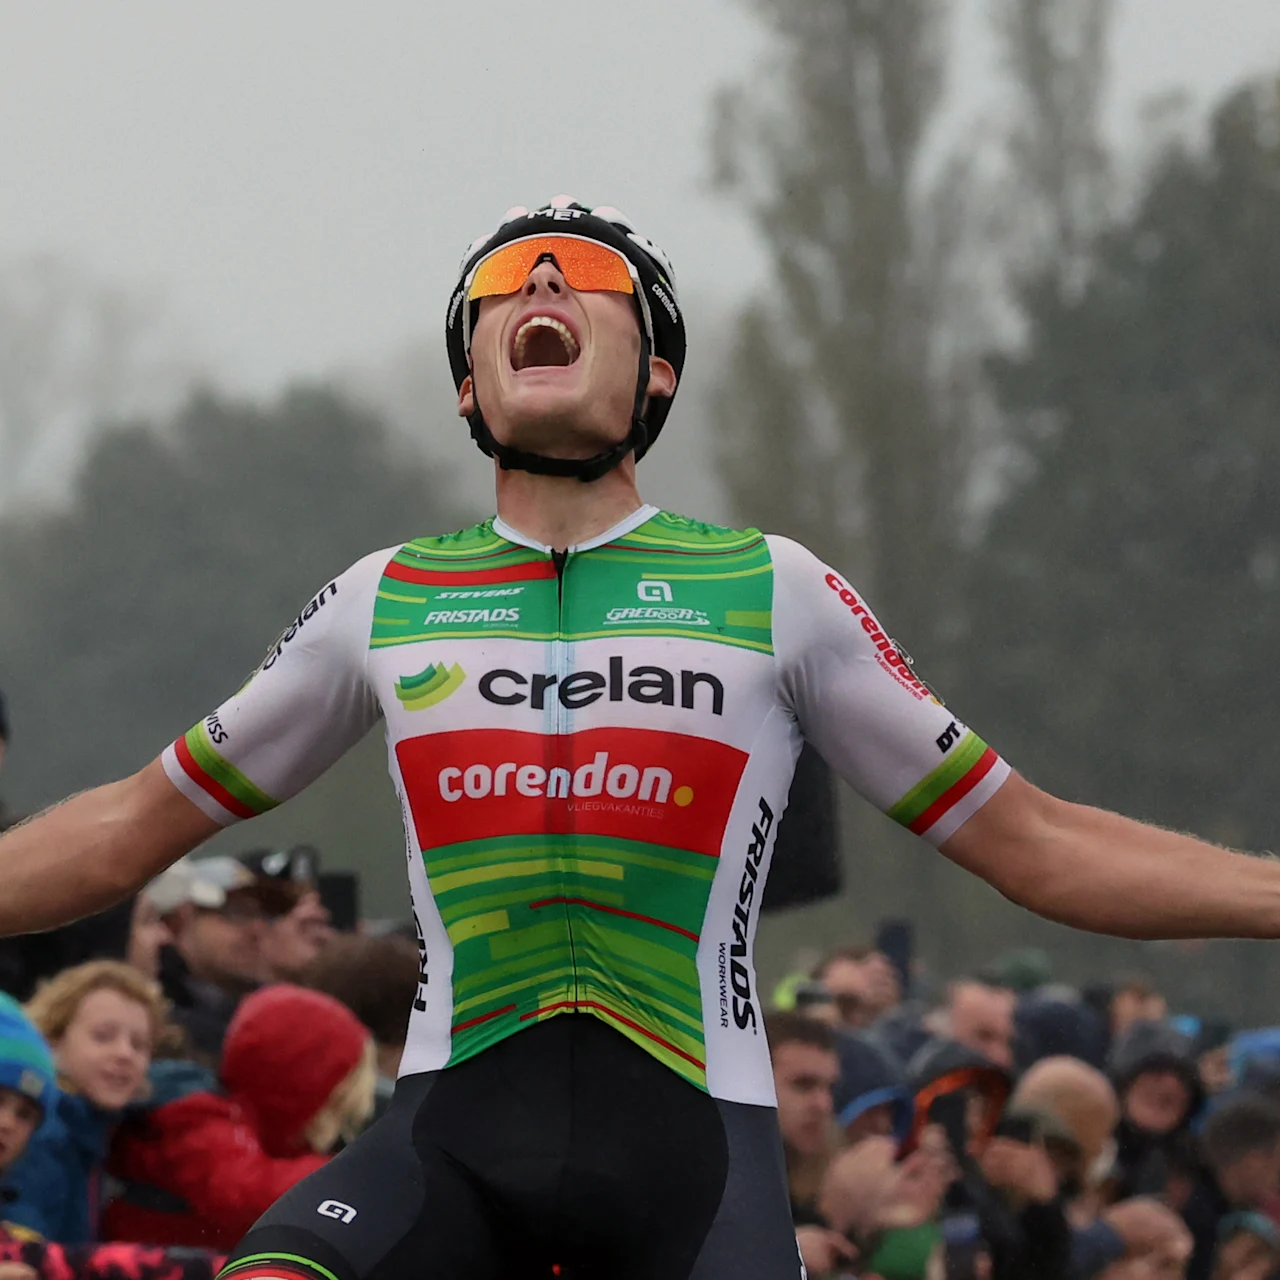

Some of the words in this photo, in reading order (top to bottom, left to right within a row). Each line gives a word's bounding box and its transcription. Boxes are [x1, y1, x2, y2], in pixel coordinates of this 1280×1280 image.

[527, 208, 587, 221] MET
[434, 587, 525, 600] STEVENS
[424, 607, 519, 625] FRISTADS
[478, 656, 724, 716] crelan
[567, 801, 665, 819] VLIEGVAKANTIES
[730, 796, 774, 1031] FRISTADS
[717, 942, 729, 1028] WORKWEAR
